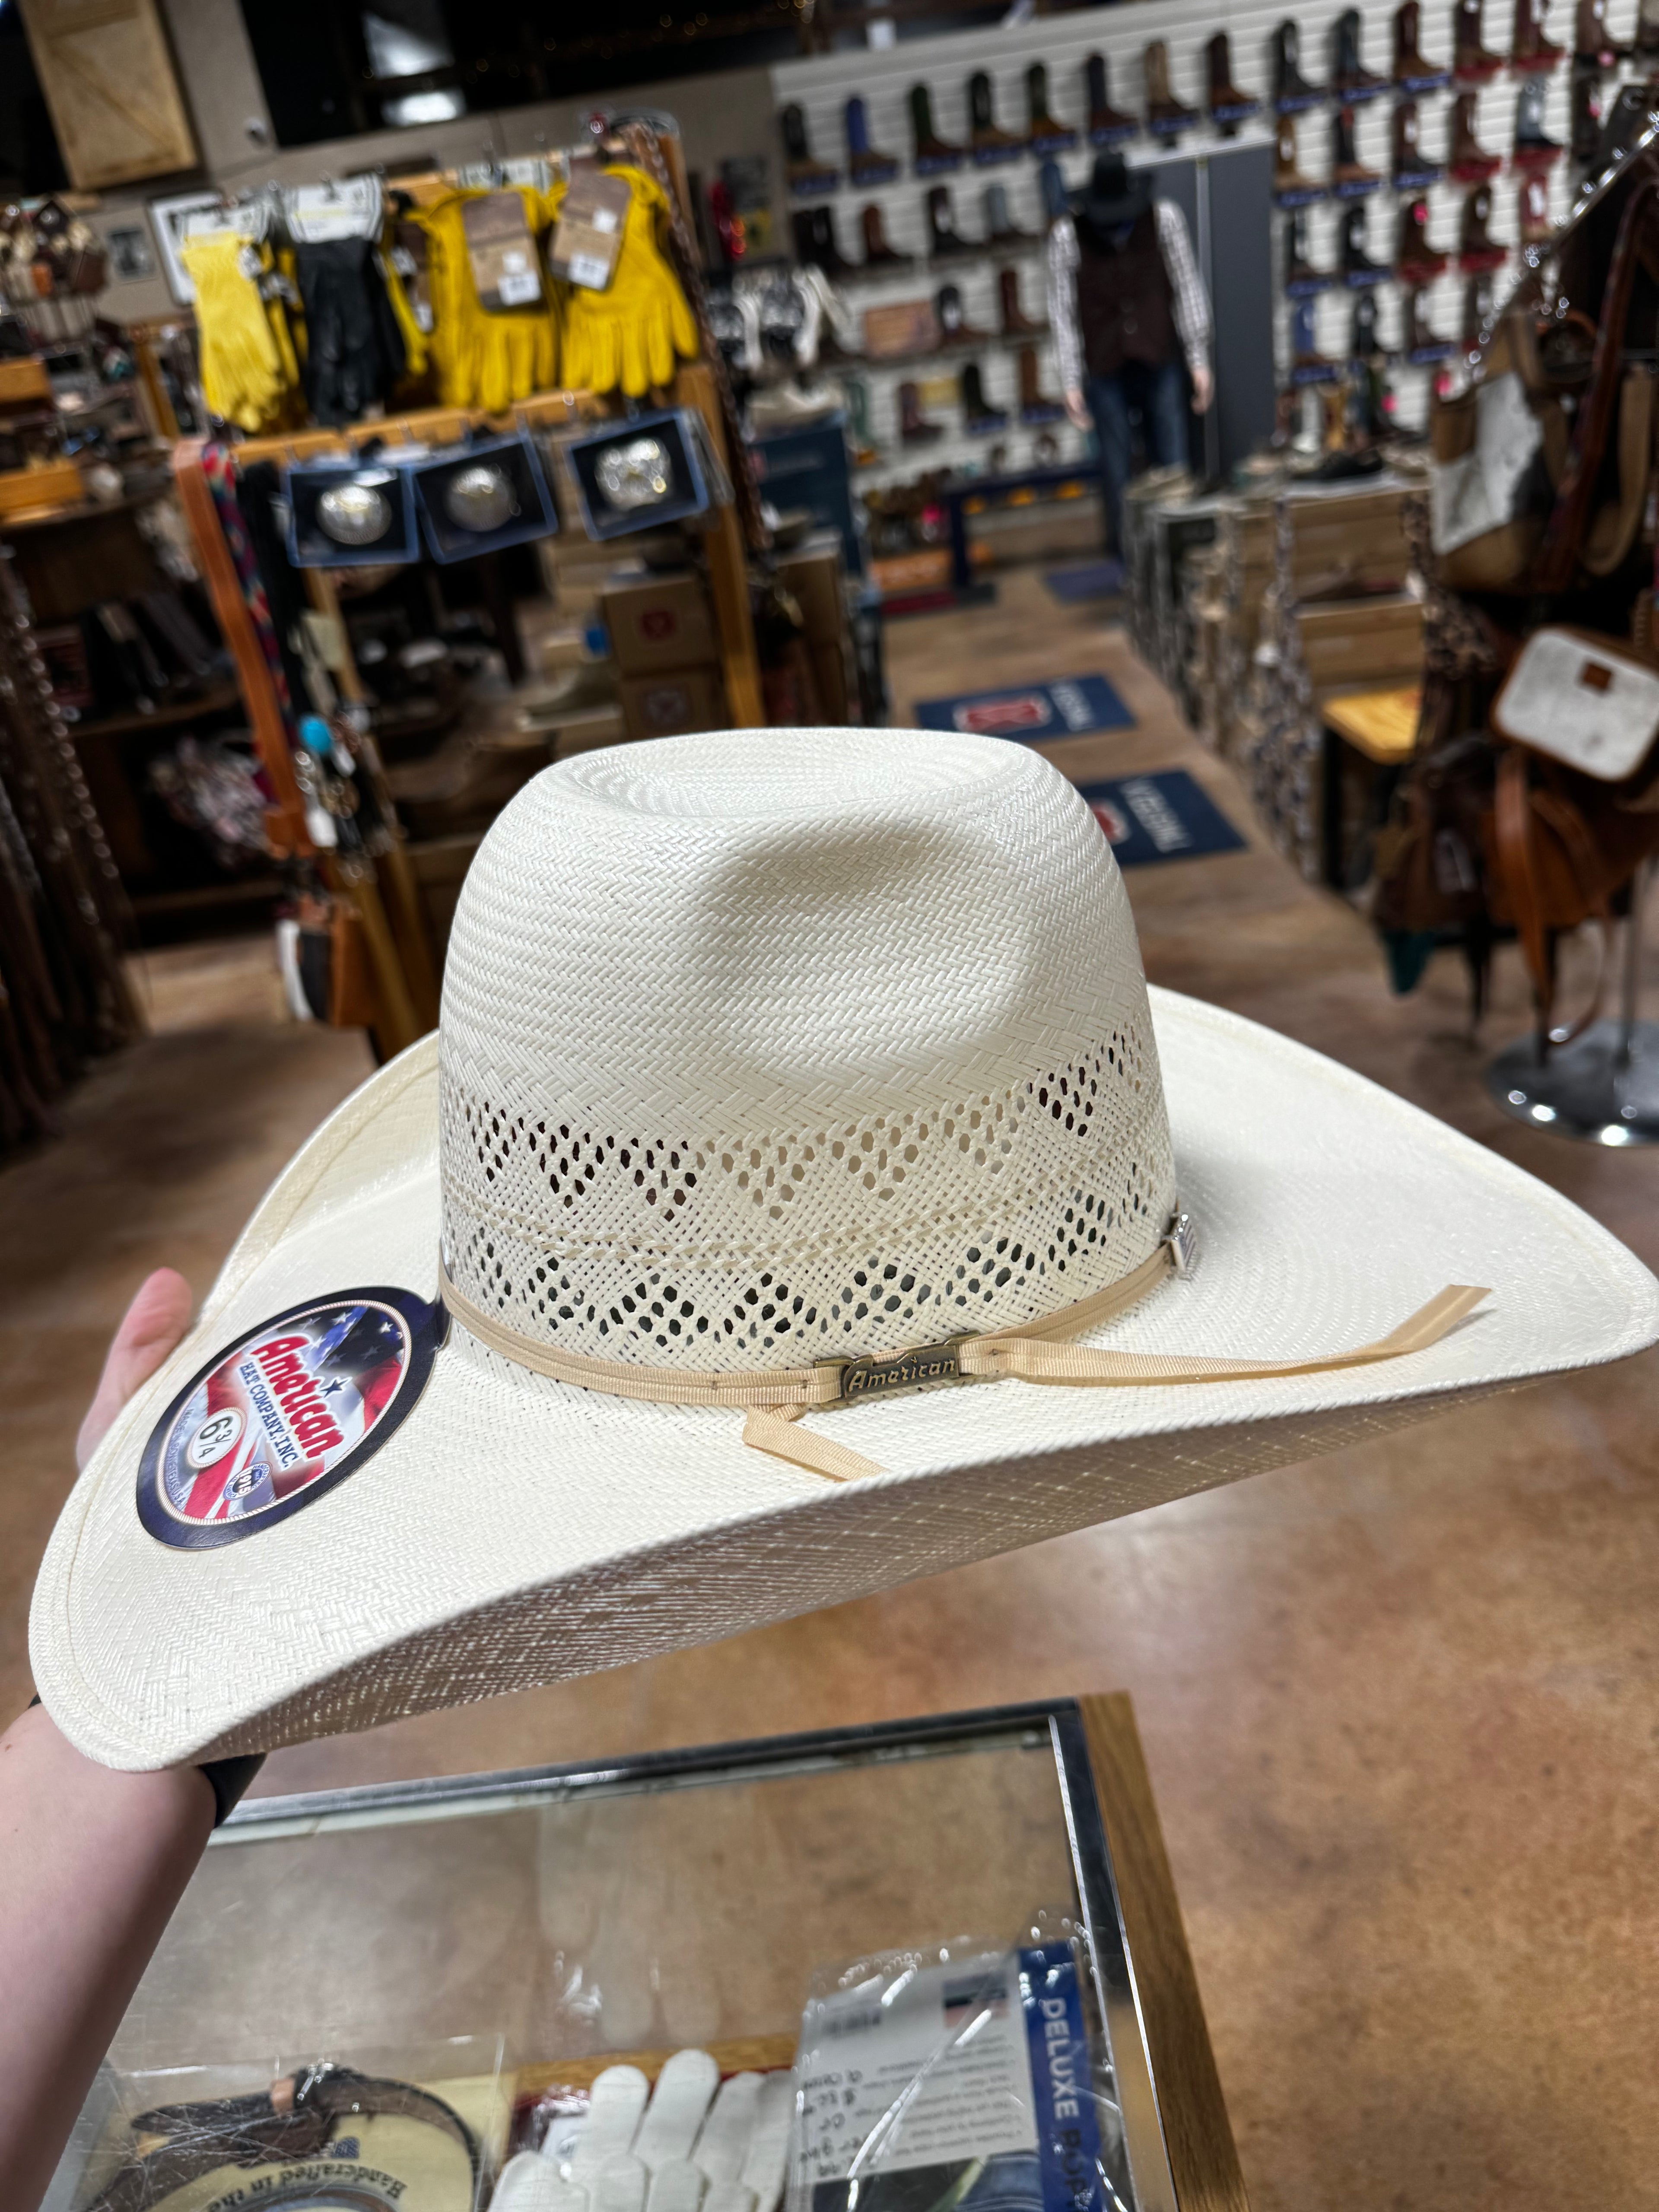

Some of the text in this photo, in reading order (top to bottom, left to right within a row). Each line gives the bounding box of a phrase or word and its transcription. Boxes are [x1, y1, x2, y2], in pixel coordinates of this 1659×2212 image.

[848, 1358, 955, 1392] American
[240, 1362, 299, 1468] HAT COMPANY, INC.
[249, 1335, 344, 1459] American
[238, 1468, 252, 1495] 1915
[1043, 1997, 1080, 2119] DELUXE
[250, 2175, 273, 2193] in
[279, 2163, 407, 2199] Handcrafted
